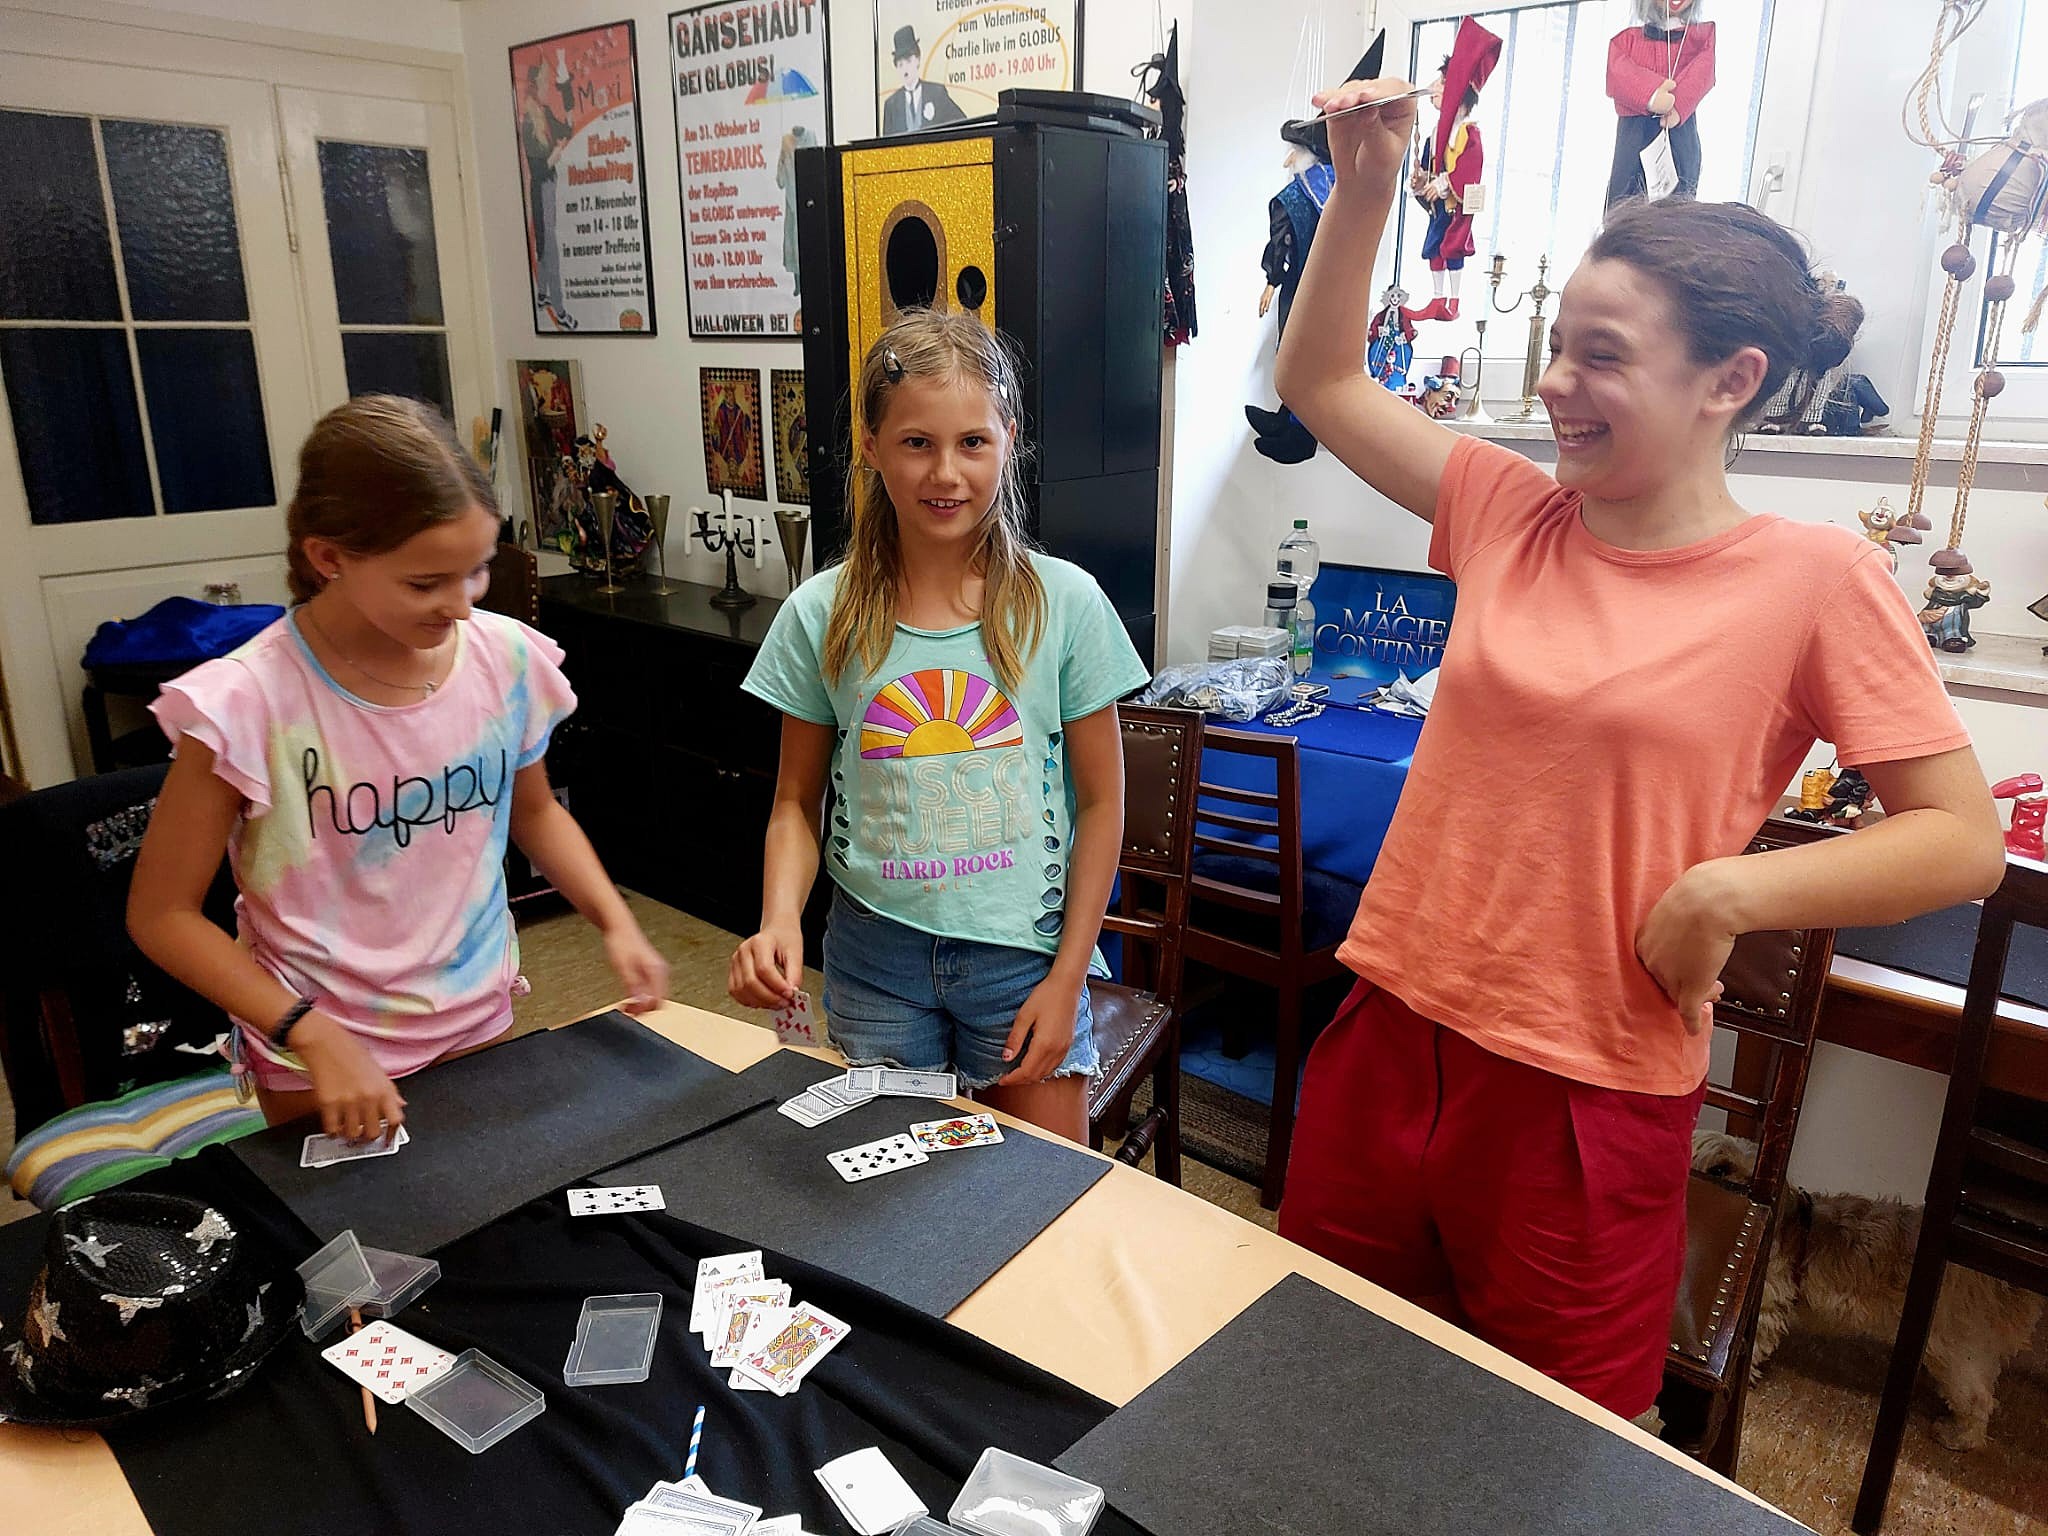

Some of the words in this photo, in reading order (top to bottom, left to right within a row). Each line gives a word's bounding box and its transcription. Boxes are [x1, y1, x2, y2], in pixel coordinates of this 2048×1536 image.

[677, 0, 817, 58] GÄNSEHAUT
[958, 19, 978, 33] zum
[984, 7, 1046, 29] Valentinstag
[945, 41, 980, 60] Charlie
[983, 38, 1000, 54] live
[1003, 36, 1016, 50] im
[1019, 26, 1061, 49] GLOBUS
[679, 69, 702, 97] BEI
[704, 54, 775, 93] GLOBUS!
[949, 71, 966, 84] von
[970, 63, 996, 81] 13.00
[1007, 57, 1034, 76] 19.00
[1037, 53, 1056, 72] Uhr
[699, 124, 713, 140] 31.
[714, 120, 747, 138] Oktober
[685, 143, 767, 175] TEMERARIUS,
[566, 203, 578, 213] am
[581, 196, 593, 211] 17.
[595, 191, 637, 210] November
[702, 205, 734, 222] GLOBUS
[576, 223, 592, 234] von
[594, 218, 603, 233] 14
[624, 214, 639, 230] Uhr
[719, 229, 731, 243] Sie
[733, 226, 749, 242] sich
[751, 229, 766, 242] von
[562, 243, 571, 257] in
[572, 244, 602, 257] unserer
[693, 252, 715, 268] 14.00
[723, 250, 746, 267] 18.00
[747, 249, 763, 265] Uhr
[693, 279, 708, 290] von
[695, 313, 765, 333] HALLOWEEN
[770, 313, 789, 332] BEI
[1375, 591, 1410, 615] LA
[1342, 607, 1447, 646] MAGIE
[860, 749, 1029, 814] DISCO
[303, 747, 506, 849] happy
[861, 799, 1032, 855] QUEEN
[881, 859, 947, 880] HARD
[953, 849, 1016, 877] ROCK
[923, 878, 973, 893] BALI
